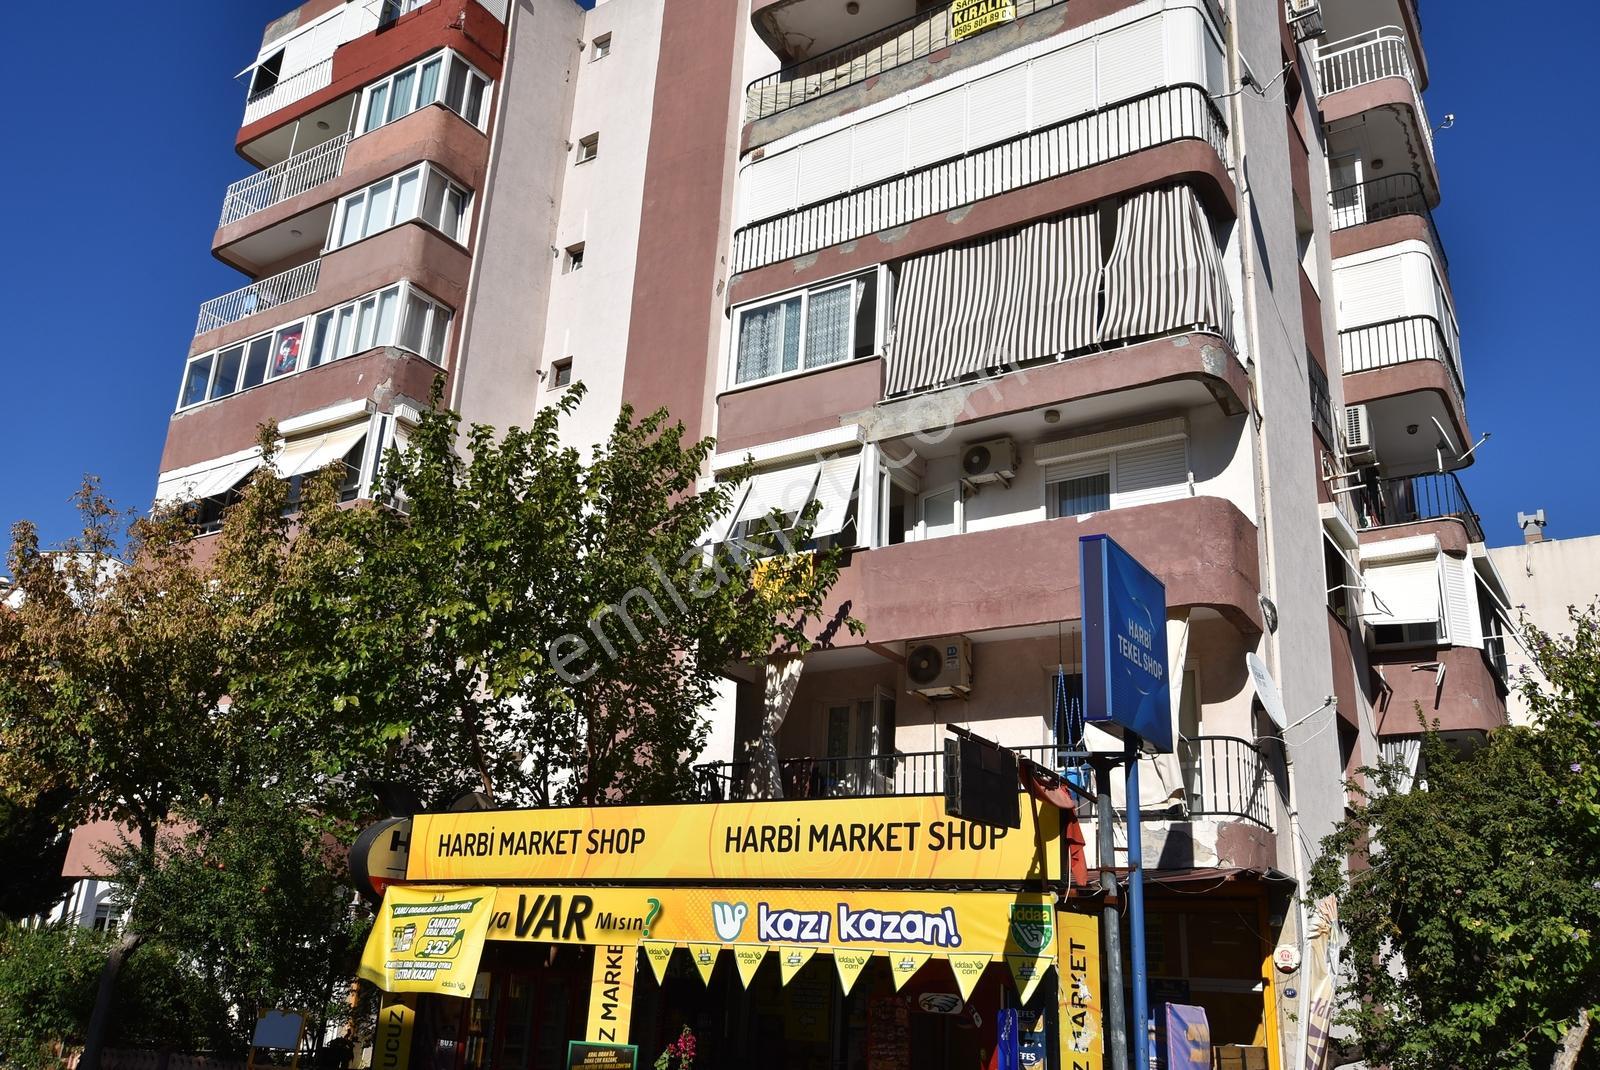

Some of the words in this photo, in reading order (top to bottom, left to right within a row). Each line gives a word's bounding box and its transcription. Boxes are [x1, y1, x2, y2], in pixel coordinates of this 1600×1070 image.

[954, 22, 972, 37] 0505
[974, 16, 988, 28] 804
[990, 12, 1000, 21] 89
[1128, 617, 1152, 651] HARBİ
[1117, 633, 1143, 668] TEKEL
[1142, 652, 1163, 681] SHOP
[438, 825, 495, 857] HARBİ
[499, 829, 582, 856] MARKET
[585, 827, 646, 854] SHOP
[725, 817, 801, 853] HARBİ
[808, 822, 921, 852] MARKET
[928, 821, 1008, 851] SHOP
[428, 918, 460, 928] CANLIDA
[514, 893, 594, 941] VAR
[758, 902, 832, 943] kazı
[837, 902, 962, 948] kazan!
[1012, 905, 1051, 922] iddaa
[425, 940, 449, 955] 3.25
[738, 951, 753, 959] iddaa
[743, 957, 757, 965] com
[839, 956, 856, 964] iddaa
[411, 969, 436, 980] KAZAN
[954, 961, 973, 969] iddaa
[601, 945, 623, 1021] MARKE
[1070, 937, 1089, 1052] ARKET
[383, 1009, 405, 1067] UCUZ
